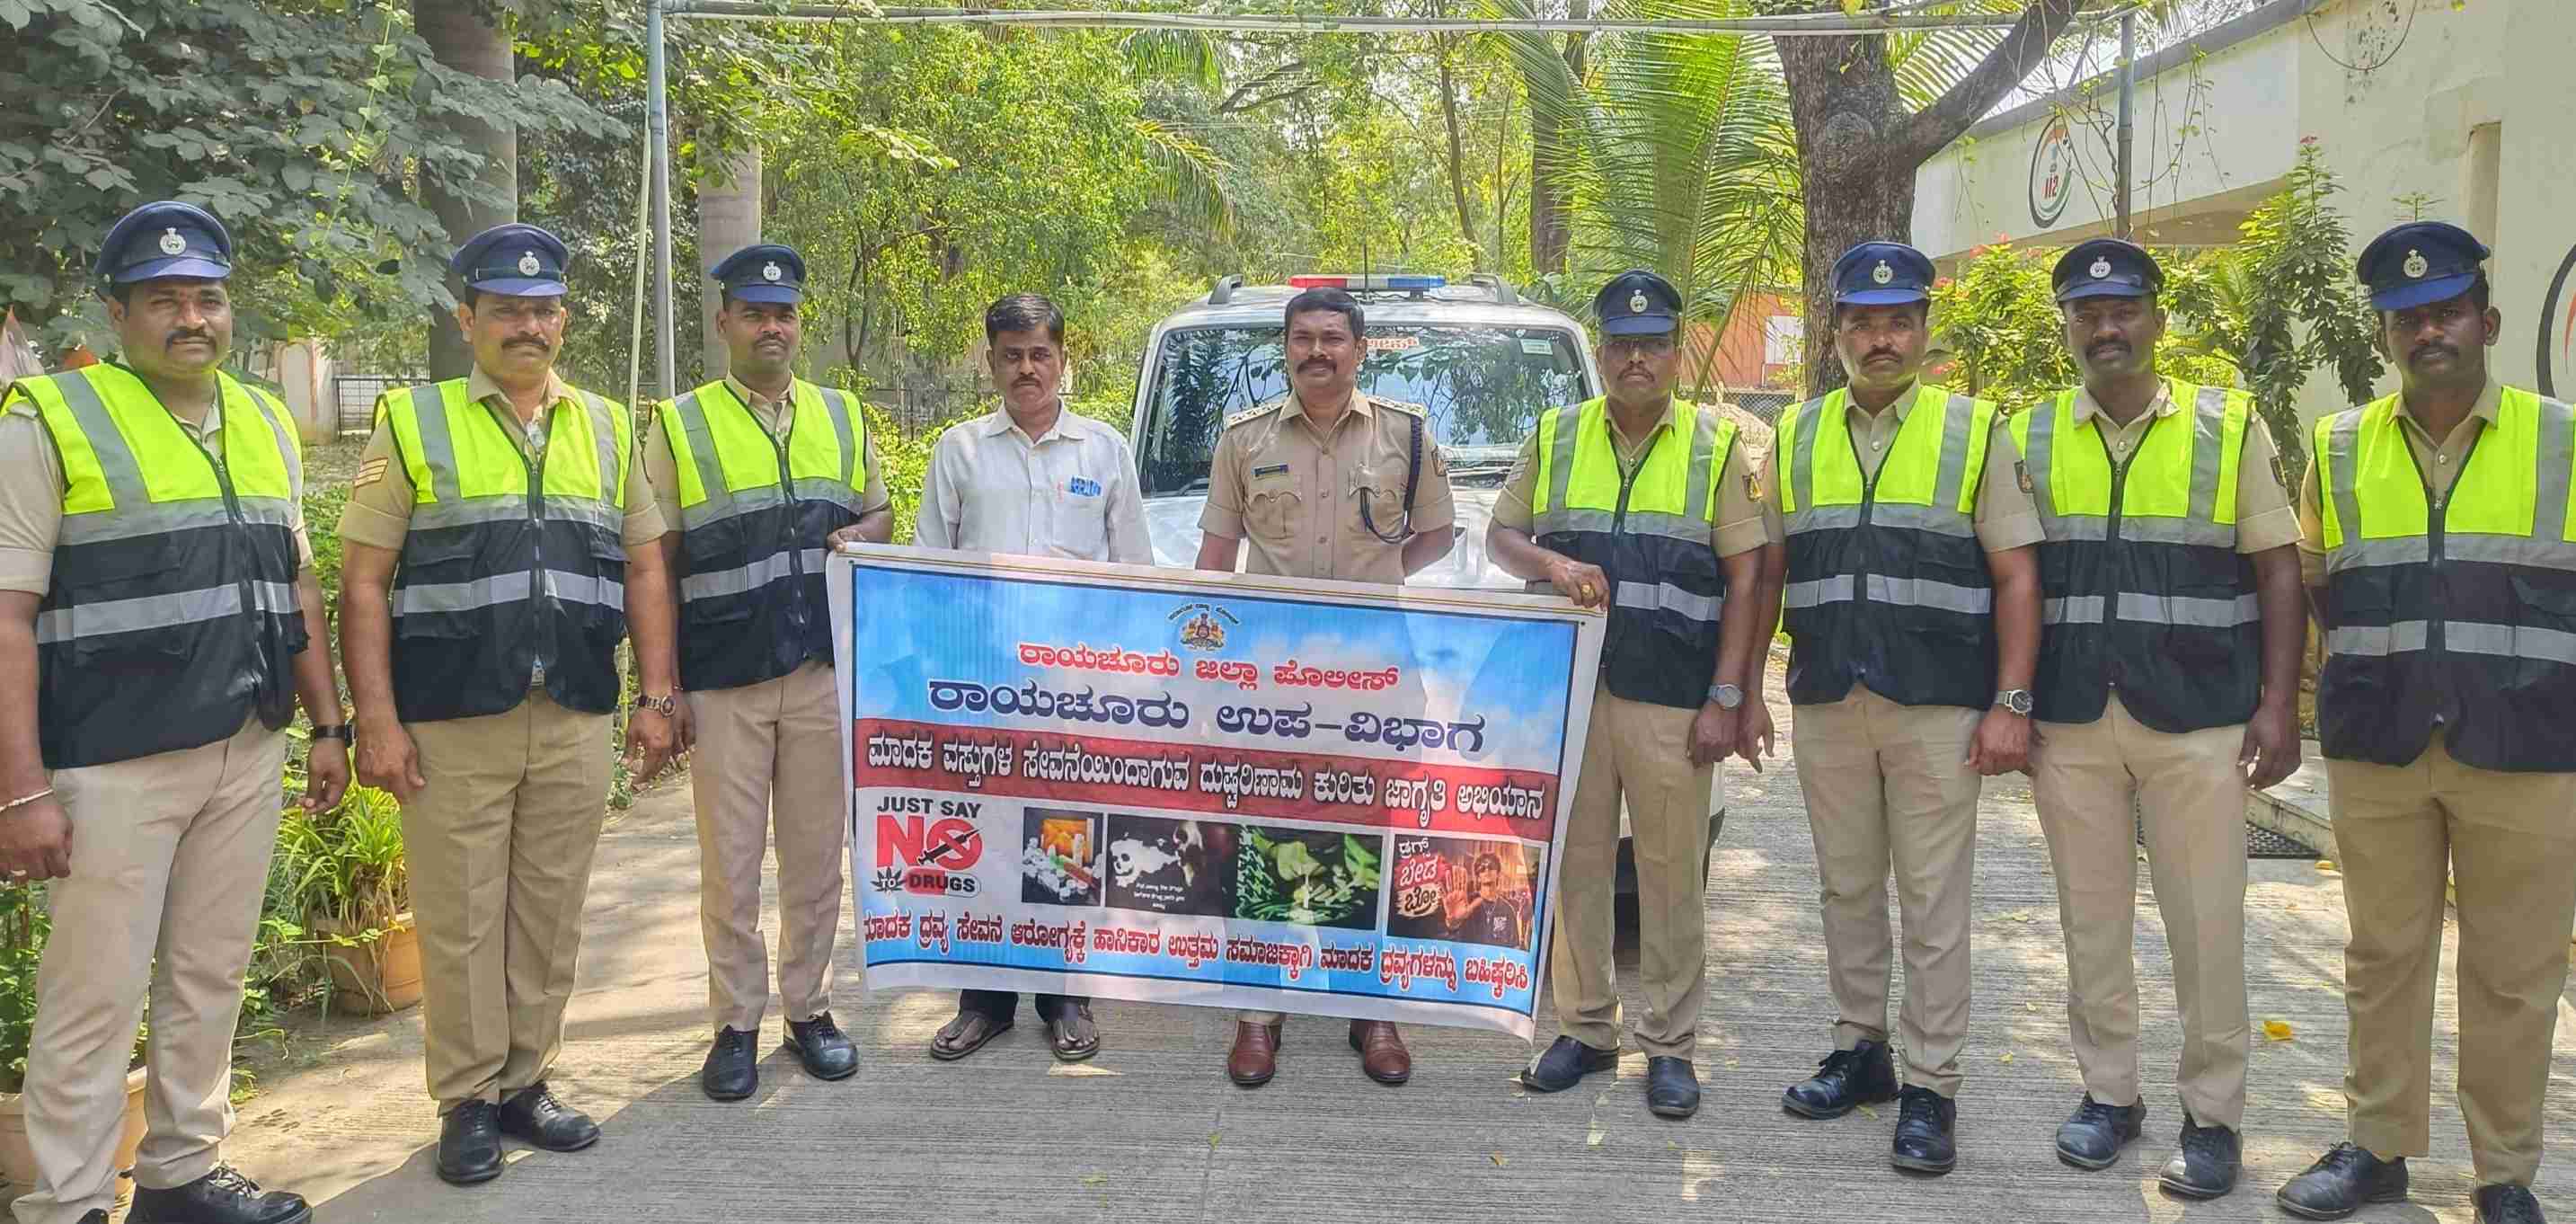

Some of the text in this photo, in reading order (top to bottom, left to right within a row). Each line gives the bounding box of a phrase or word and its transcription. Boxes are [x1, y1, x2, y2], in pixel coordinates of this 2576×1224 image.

[1019, 643, 1399, 691] ರಾಯಚೂರು ಜಿಲ್ಲಾ ಪೊಲೀಸ್
[929, 679, 1486, 752] ರಾಯಚೂರು ಉಪ-ವಿಭಾಗ
[868, 733, 1545, 828] ಮಾದಕ ವಸ್ತುಗಳ ಸೇವನೆಯಿಂದಾಗುವ ದುಷ್ಪರಿಣಾಮ ಕುರಿತು ಜಾಗೃತಿ ಅಭಿಯಾನ
[877, 796, 982, 819] JUST SAY
[877, 814, 983, 871] NO
[881, 879, 897, 890] TO
[909, 873, 976, 893] DRUGS
[919, 909, 949, 953] ದ್ರವ್ಯ
[957, 914, 1003, 944] ಸೇವನೆ
[1011, 918, 1085, 962] ಆರೋಗ್ಯಕ್ಕೆ
[1093, 927, 1161, 954] ಹಾನಿಕಾರ
[1169, 927, 1218, 968] ಉತ್ತಮ
[1226, 933, 1312, 979] ಸಮಾಜಕ್ಕಾಗಿ
[1321, 942, 1373, 971] ಮಾದಕ
[1381, 945, 1456, 991] ದ್ರವ್ಯಗಳನ್ನು
